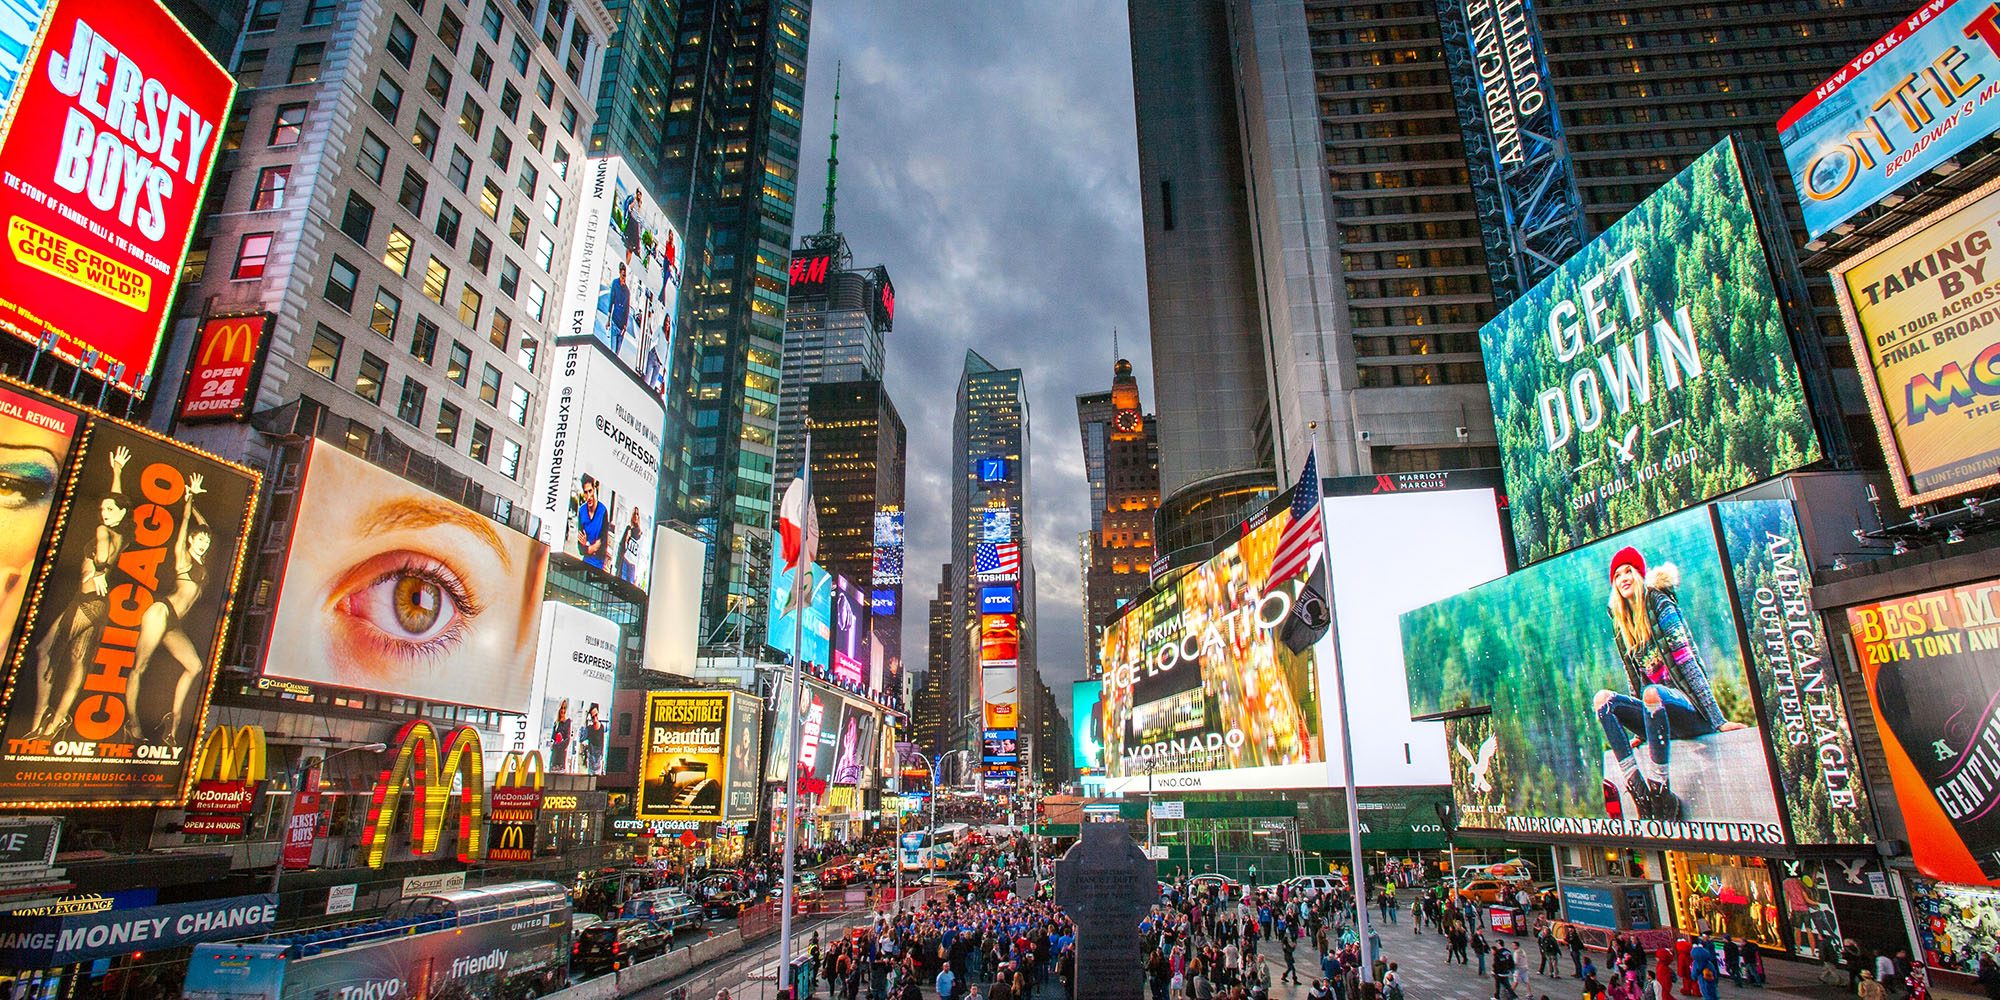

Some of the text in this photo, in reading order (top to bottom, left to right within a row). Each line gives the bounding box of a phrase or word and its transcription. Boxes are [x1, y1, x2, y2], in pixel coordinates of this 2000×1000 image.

[1815, 69, 1848, 100] NEW
[1851, 32, 1904, 72] YORK,
[48, 18, 213, 185] JERSEY
[1471, 17, 1525, 166] AMERICAN
[1803, 45, 1986, 202] ON THE
[1884, 100, 1975, 178] BROADWAY'S
[54, 106, 174, 242] BOYS
[4, 170, 171, 276] THE STORY OF FRANKIE VALLI & THE FOUR SEASONS
[18, 238, 79, 274] GOES
[74, 244, 144, 288] CROWD
[576, 208, 600, 302] #CELEBRATEYOU
[1861, 230, 1993, 306] TAKING
[1937, 256, 1988, 301] BY
[1548, 249, 1643, 363] GET
[1877, 283, 2000, 348] ON TOUR ACROSS
[1881, 338, 1931, 369] FINAL
[200, 379, 236, 398] 24
[201, 367, 245, 379] OPEN
[1538, 304, 1704, 452] DOWN
[186, 398, 241, 412] HOURS
[25, 409, 66, 434] REVIVAL
[545, 386, 573, 513] @EXPRESSRUNWAY
[1399, 471, 1449, 482] MARRIOTT
[1400, 479, 1446, 490] MARQUIS
[1572, 489, 1598, 511] STAY
[1636, 466, 1660, 488] NOT
[977, 573, 1018, 583] TOSHIBA
[74, 462, 186, 740] CHICAGO
[990, 596, 1012, 604] TDK
[1147, 610, 1193, 646] PRIME
[1856, 598, 1950, 644] BEST
[1865, 639, 1911, 665] 2014
[1911, 632, 1963, 659] TONY
[1753, 586, 1809, 747] OUTFITTERS
[1765, 530, 1858, 810] AMERICAN EAGLE
[7, 739, 184, 760] THE ONE THE ONLY
[653, 727, 721, 745] Beautiful
[653, 745, 664, 754] The
[1127, 728, 1246, 765] VORNADO
[1931, 738, 1959, 762] A
[1182, 753, 1223, 765] TRUST
[15, 771, 164, 783] CHICAGOTHEMUSICAL.COM
[1158, 777, 1202, 787] VNO.COM
[196, 801, 242, 810] Restaurant
[493, 792, 541, 802] McDonald's
[184, 821, 241, 830] OPEN 24 HOURS
[289, 812, 319, 829] JERSEY
[292, 827, 313, 843] BOYS
[614, 820, 699, 830] GIFTS LUGGAGE
[1508, 816, 1784, 845] AMERICAN EAGLE OUTFITTERS
[55, 899, 114, 914] EXCHANGE
[57, 903, 279, 953] MONEY CHANGE
[511, 918, 543, 932] UNITED
[0, 932, 58, 951] ANGE
[451, 948, 509, 980] friendly
[341, 978, 400, 1000] Tokyo
